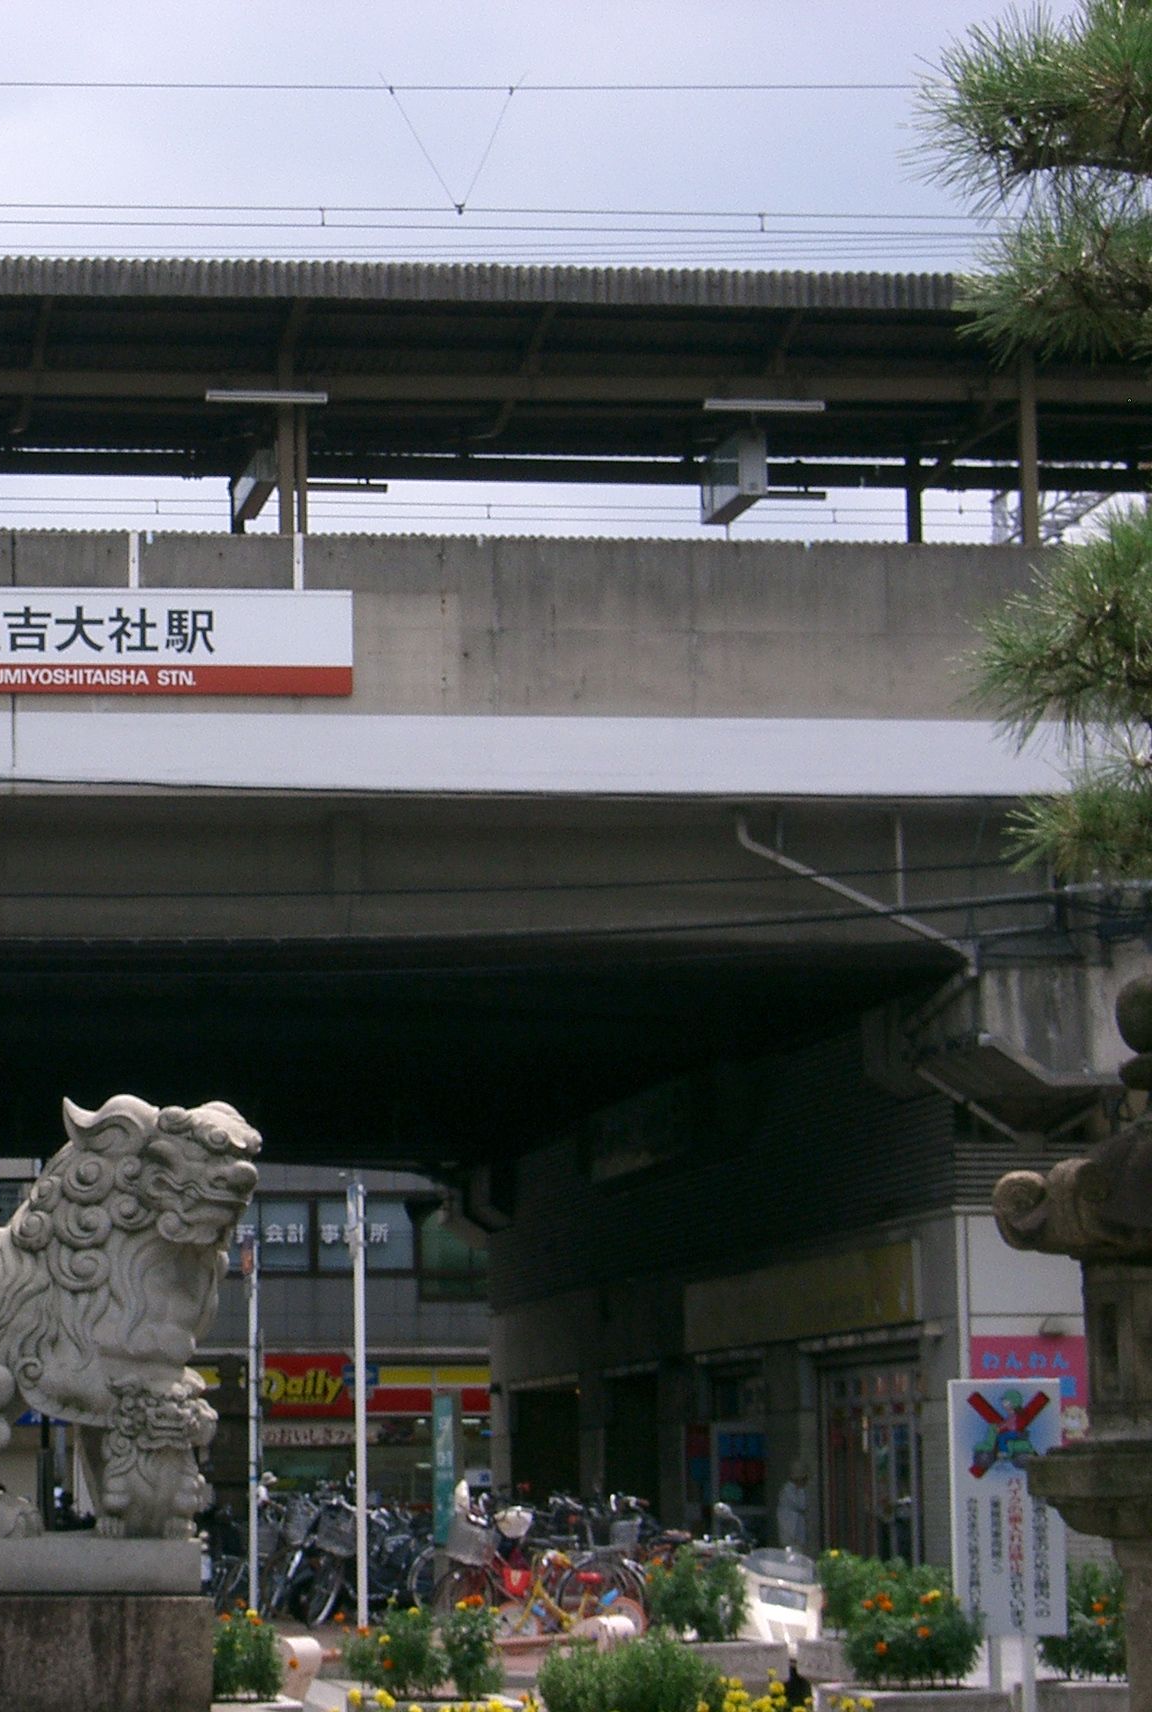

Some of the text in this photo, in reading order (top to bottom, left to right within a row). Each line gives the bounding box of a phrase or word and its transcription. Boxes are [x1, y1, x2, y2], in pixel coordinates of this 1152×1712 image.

[158, 671, 197, 687] STN.
[982, 1351, 1070, 1370] わんわん
[262, 1369, 343, 1405] Daily
